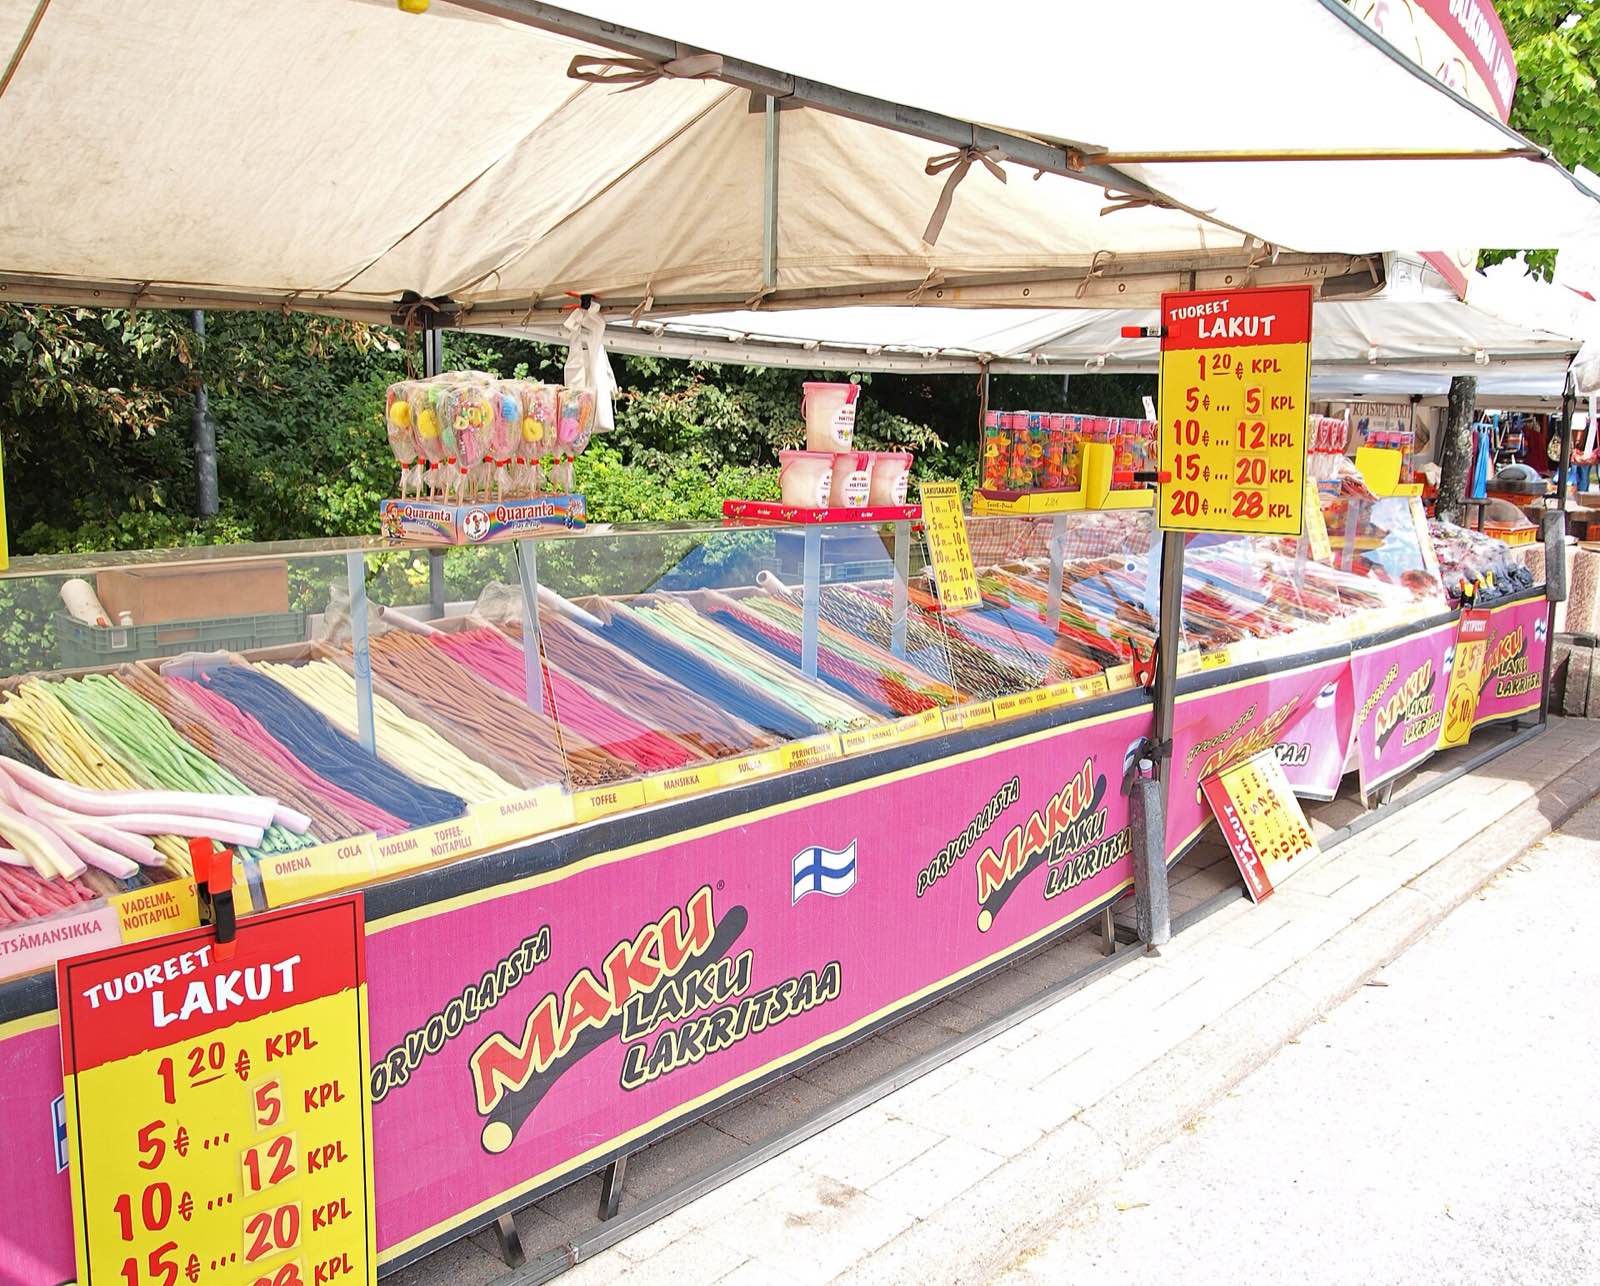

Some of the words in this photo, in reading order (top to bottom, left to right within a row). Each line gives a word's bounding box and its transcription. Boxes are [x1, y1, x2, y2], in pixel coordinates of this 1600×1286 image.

[1170, 299, 1230, 321] TUOREET
[1197, 314, 1276, 339] LAKUT
[1251, 359, 1282, 374] KPL
[1246, 387, 1261, 414] 5
[1271, 395, 1296, 411] KPL
[1237, 421, 1266, 450] 12
[1270, 433, 1295, 448] KPL
[1235, 458, 1267, 486] 20
[1269, 468, 1294, 484] KPL
[404, 504, 451, 522] Quaranta
[496, 501, 555, 523] Quaranta
[1232, 491, 1264, 520] 28
[1268, 502, 1293, 519] KPL
[500, 797, 537, 817] BANAANI
[590, 792, 617, 806] TOFFEE
[663, 774, 700, 791] MANSIKKA
[431, 835, 472, 857] NOITAPILLI
[433, 827, 464, 842] TOFFEE-
[916, 776, 1020, 898] PORVOOLAISTA
[976, 757, 1095, 905] MAKU
[1047, 808, 1107, 866] LAKU
[1223, 802, 1258, 866] LAKUT
[275, 855, 311, 876] OMENA
[337, 843, 362, 860] COLA
[379, 837, 418, 858] VADELMA
[1044, 825, 1132, 900] LAKRITSA
[121, 890, 176, 916] VADELMA-
[123, 904, 180, 931] NOITAPILLI
[83, 944, 212, 1009] TUOREET
[151, 955, 301, 1028] LAKUT
[470, 885, 716, 1114] MAKU
[619, 950, 754, 1043] LAKU
[369, 925, 551, 1103] ORVOOLAISTA
[618, 961, 841, 1090] LAKRITSAA
[265, 1027, 318, 1062] KPL
[255, 1080, 280, 1126] 5
[304, 1080, 345, 1112] KPL
[243, 1135, 296, 1191] 12
[307, 1140, 348, 1174] KPL
[245, 1204, 300, 1262] 20
[312, 1197, 353, 1231] KPL
[314, 1252, 354, 1286] KPL
